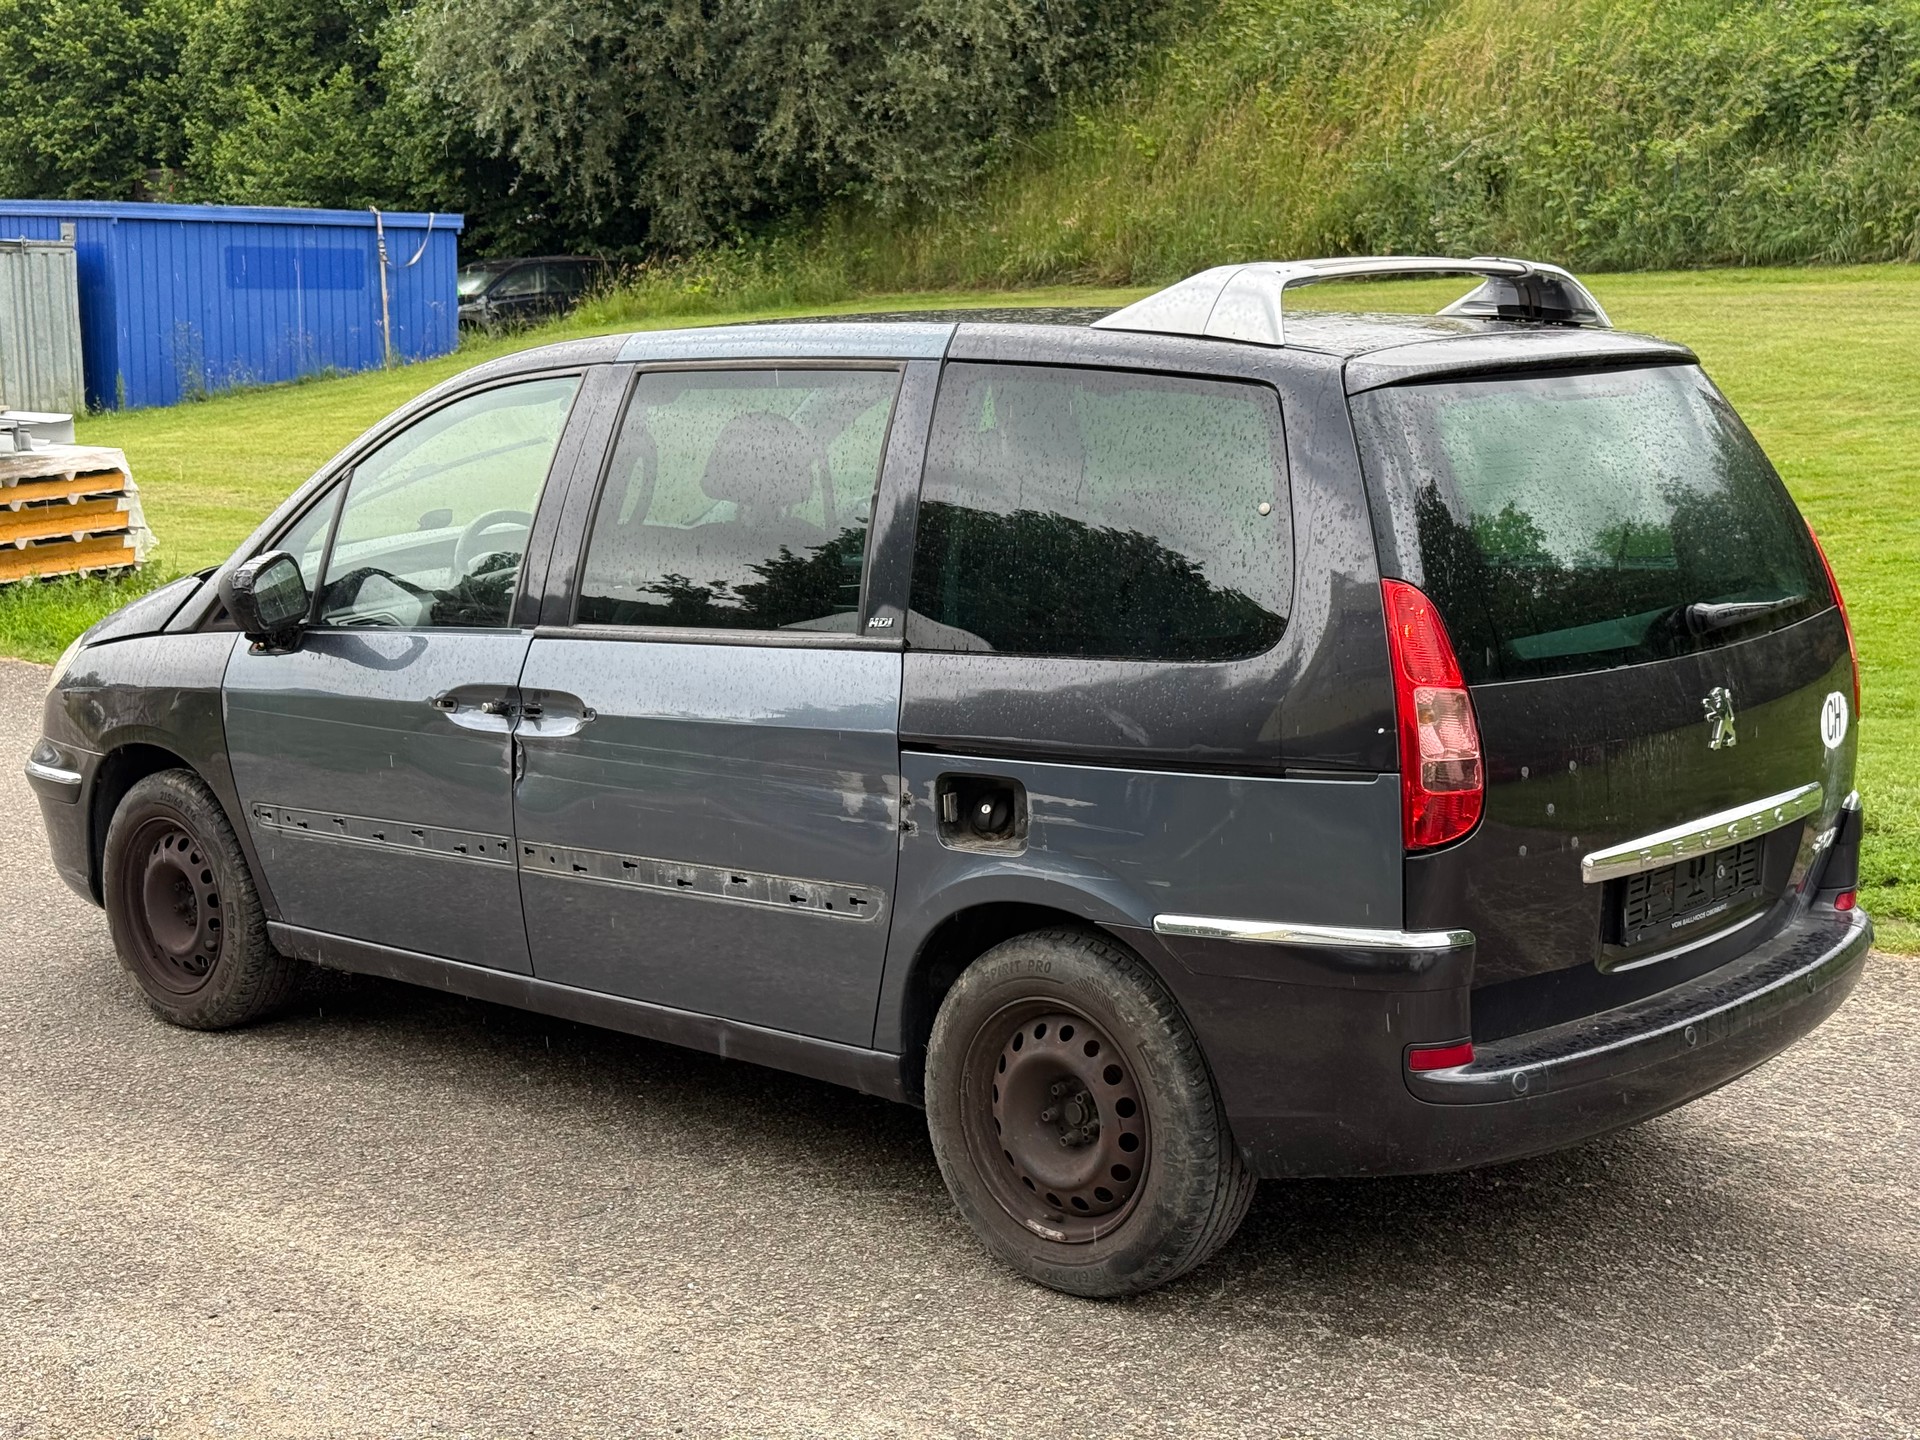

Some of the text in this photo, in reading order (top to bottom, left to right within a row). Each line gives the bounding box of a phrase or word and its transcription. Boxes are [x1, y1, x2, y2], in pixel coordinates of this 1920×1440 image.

[868, 617, 893, 628] HDI
[1826, 695, 1841, 741] CH
[1639, 800, 1803, 867] PEUGEOT
[1027, 959, 1052, 974] PRO
